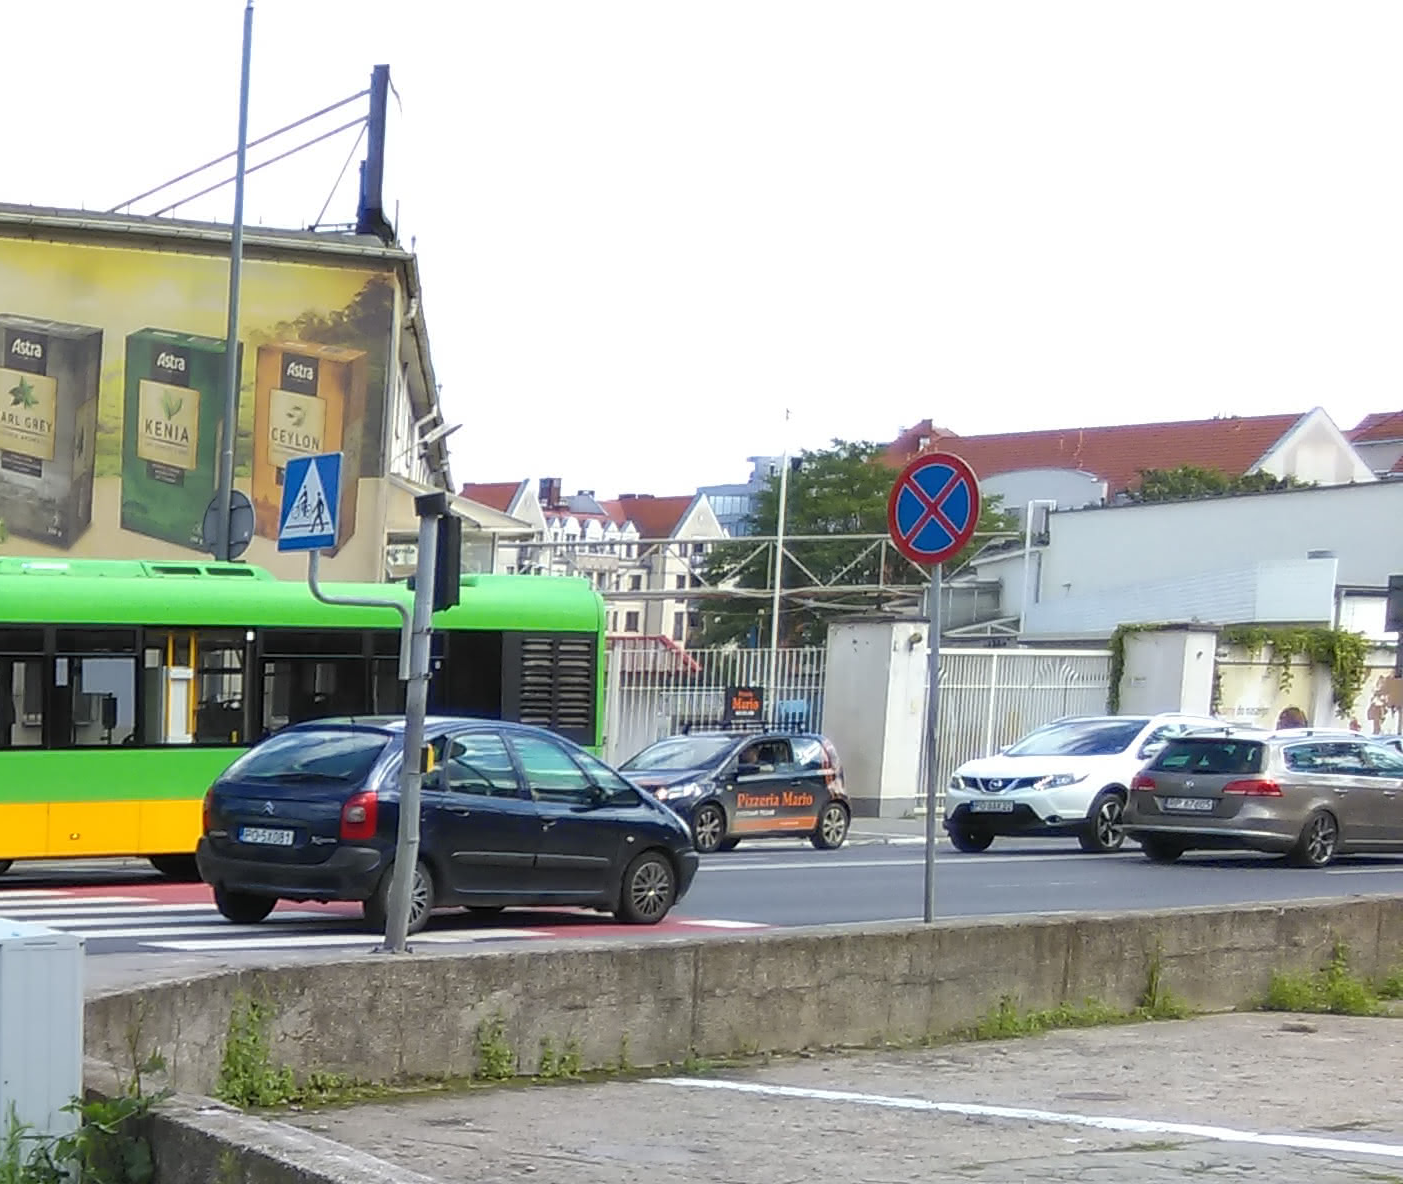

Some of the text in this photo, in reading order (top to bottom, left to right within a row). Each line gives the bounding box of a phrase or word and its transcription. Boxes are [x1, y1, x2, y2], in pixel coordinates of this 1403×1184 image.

[11, 338, 42, 358] Astra
[156, 352, 185, 372] Astra
[286, 362, 314, 381] Astra
[24, 416, 52, 433] GREY
[145, 418, 190, 443] KENIA
[271, 427, 320, 450] CEYLON
[731, 696, 760, 711] Mario
[737, 791, 813, 808] Pizzeria Mario
